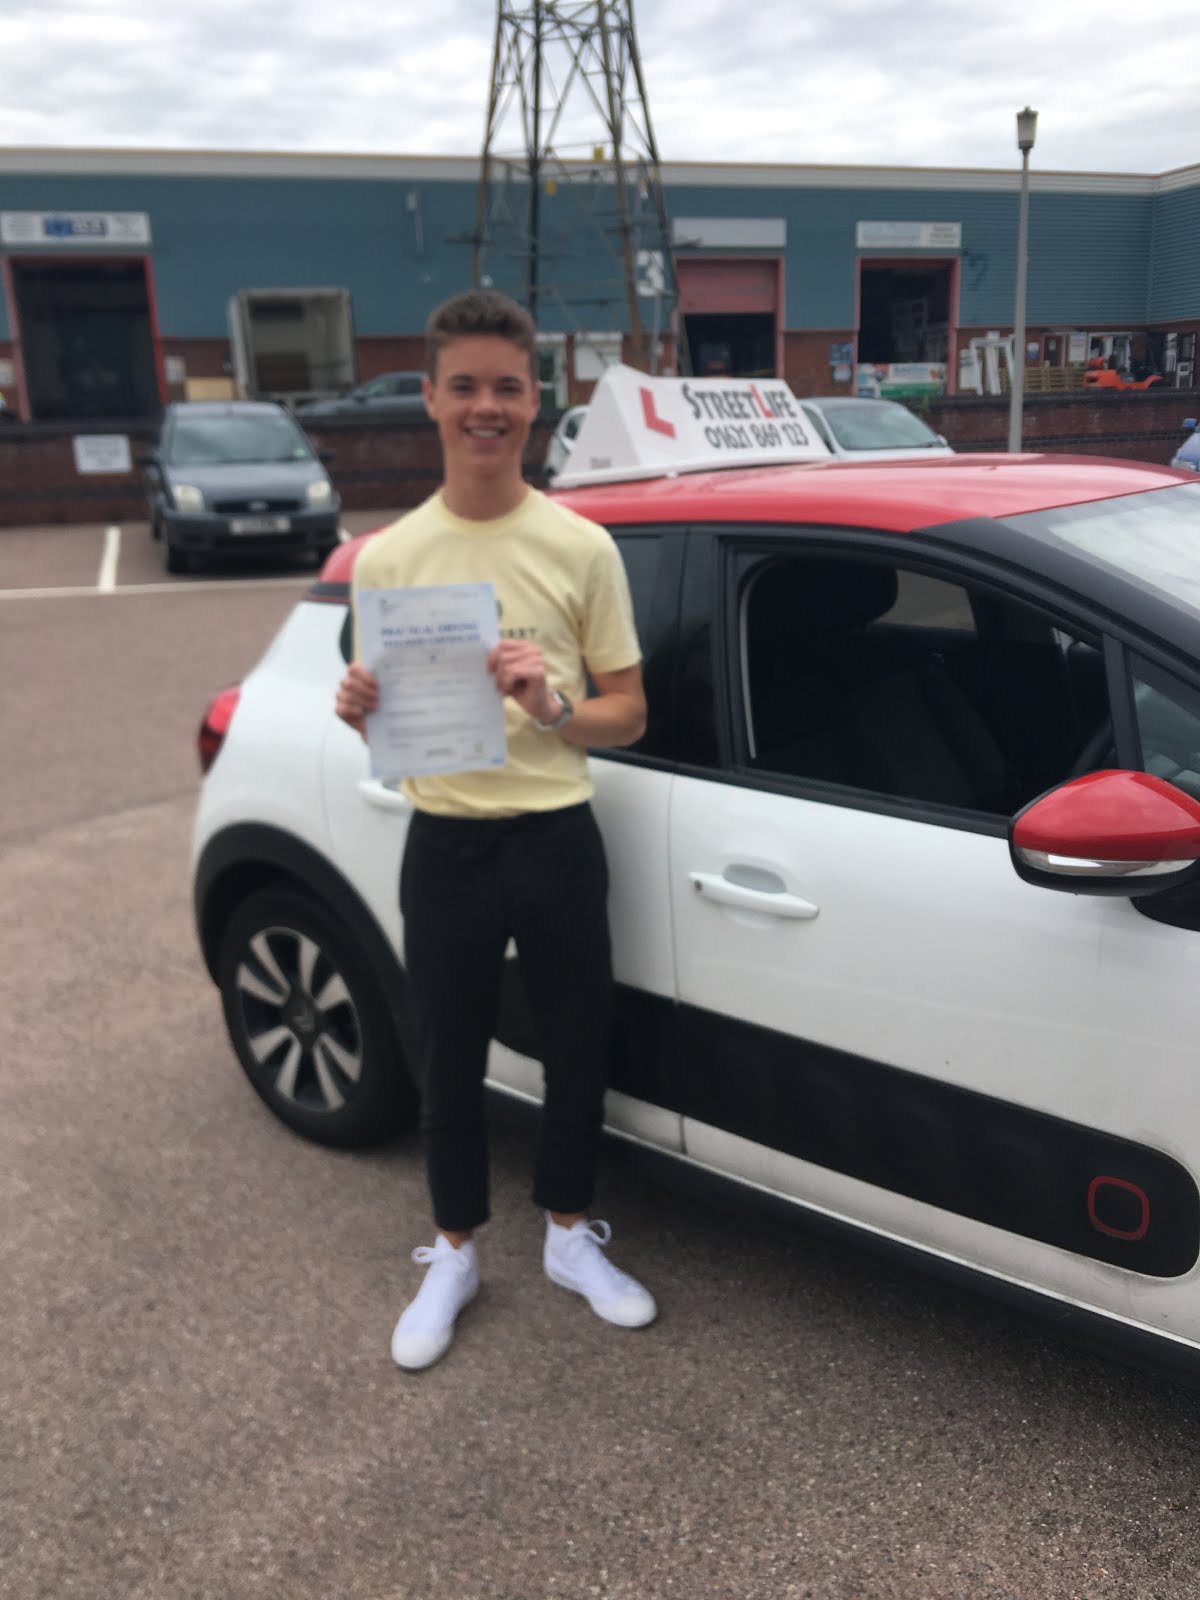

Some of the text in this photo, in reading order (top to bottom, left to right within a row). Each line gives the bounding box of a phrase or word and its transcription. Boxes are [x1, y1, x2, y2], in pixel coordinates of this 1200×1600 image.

[639, 386, 676, 439] L
[704, 421, 809, 449] 01621 869 123
